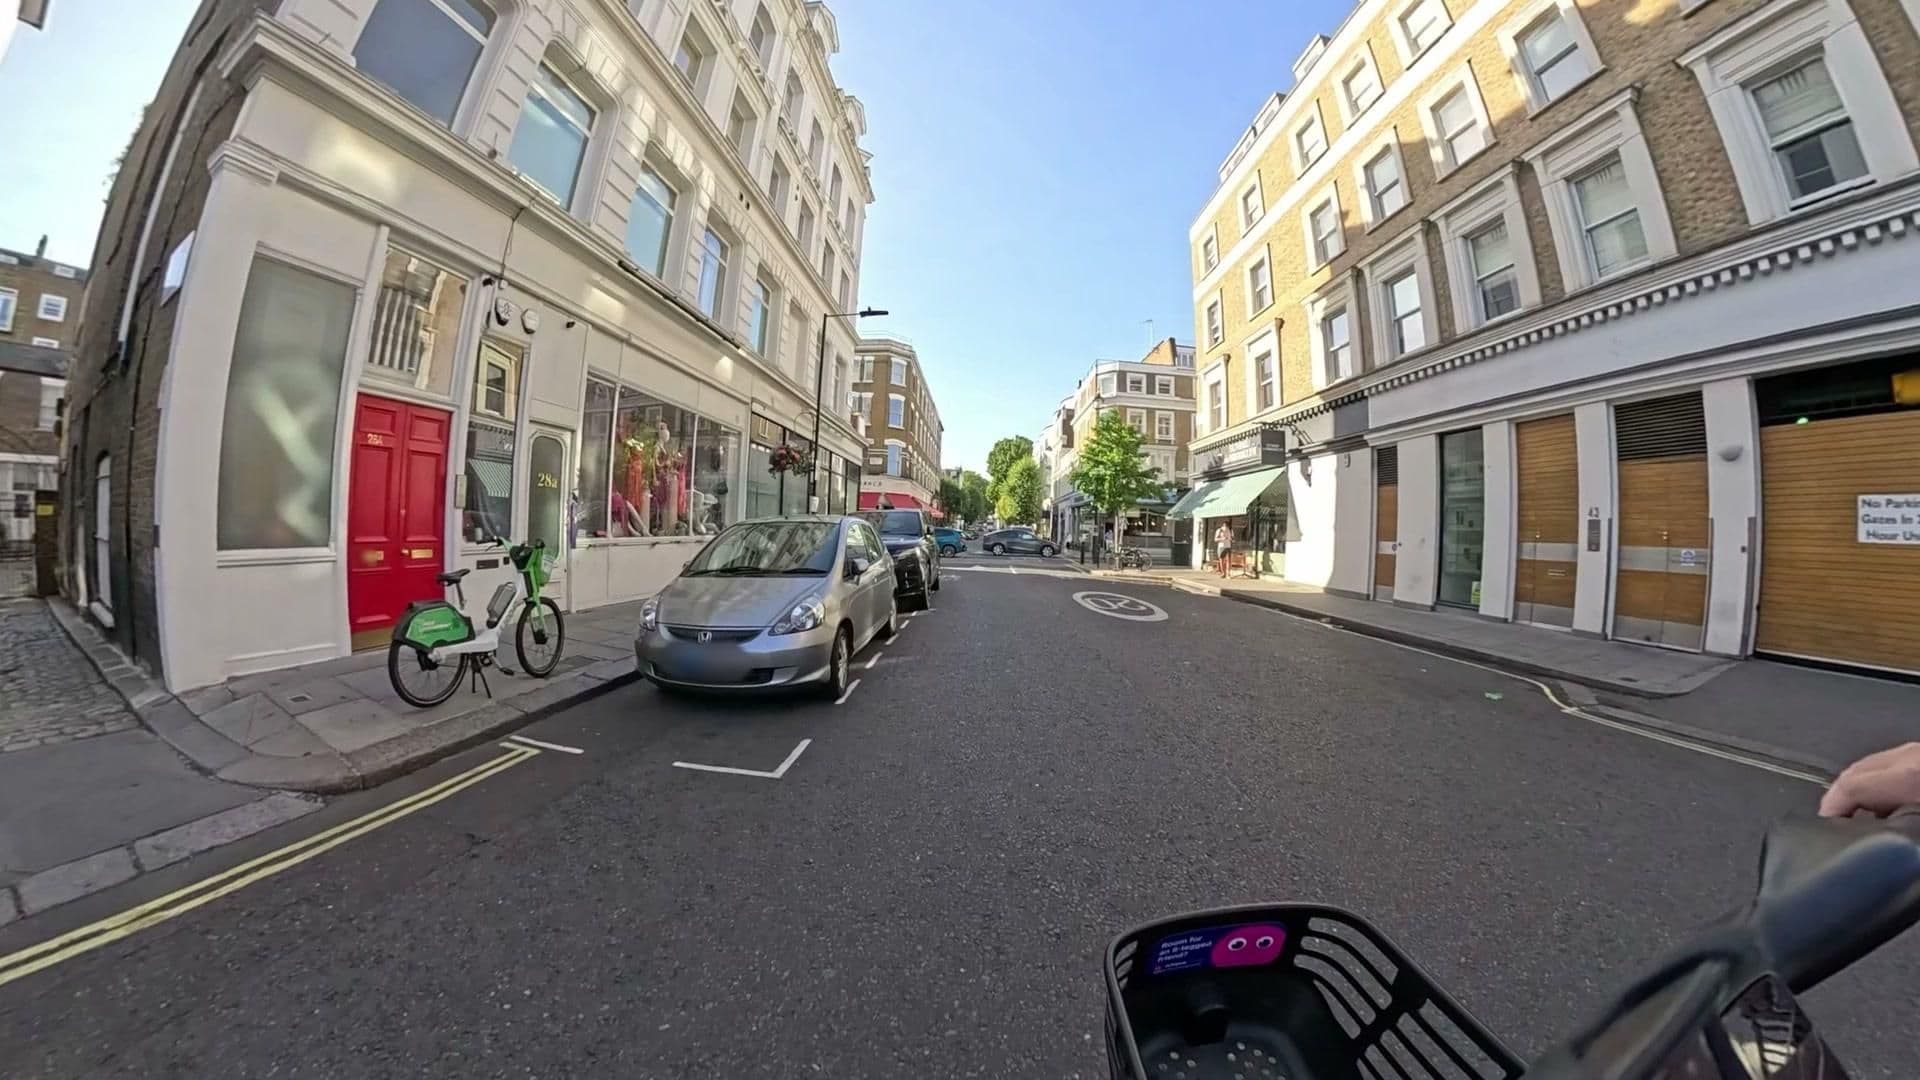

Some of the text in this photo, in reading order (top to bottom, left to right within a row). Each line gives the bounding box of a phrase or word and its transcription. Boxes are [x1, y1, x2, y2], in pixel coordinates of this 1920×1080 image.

[537, 472, 558, 488] 28a
[1862, 498, 1881, 508] No
[1866, 529, 1900, 540] Hour
[1161, 939, 1187, 949] Room
